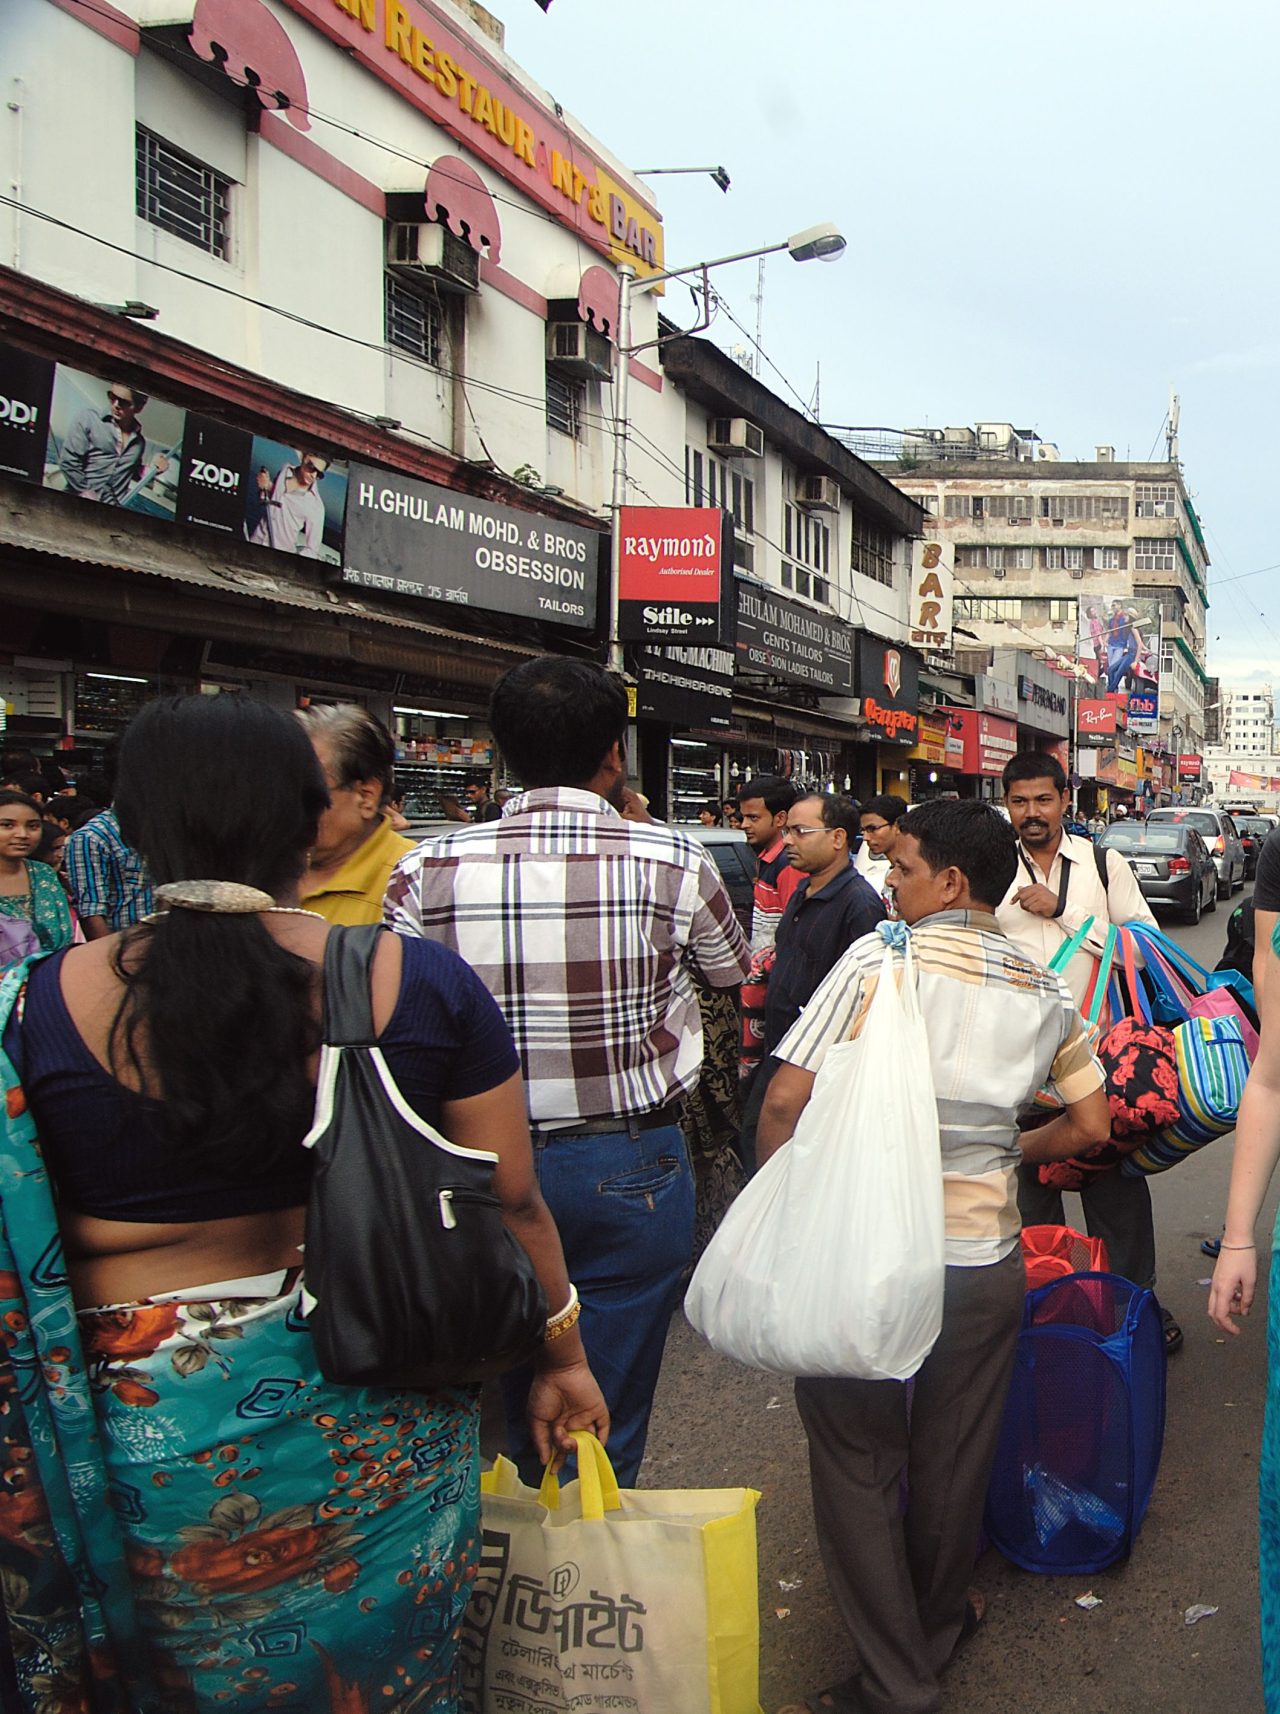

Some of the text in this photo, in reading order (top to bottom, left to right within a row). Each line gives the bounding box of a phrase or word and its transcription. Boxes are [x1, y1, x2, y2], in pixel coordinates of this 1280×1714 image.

[588, 184, 608, 221] &
[609, 193, 657, 269] BAR
[359, 483, 586, 562] H.GHULAM MOHD. & BROS
[625, 534, 716, 562] Raymond
[475, 548, 585, 590] OBSESSION
[659, 567, 715, 576] Authorised Dealer
[918, 543, 944, 630] BAR
[538, 597, 584, 616] TAILORS
[643, 607, 693, 625] Stile
[647, 627, 669, 635] Lindsay
[763, 632, 790, 652] GENTS
[791, 642, 823, 663] TAILORS
[780, 609, 823, 643] MOHAMED
[831, 631, 852, 654] BROS.
[749, 648, 833, 685] OBSESSION LADIES TAILORS
